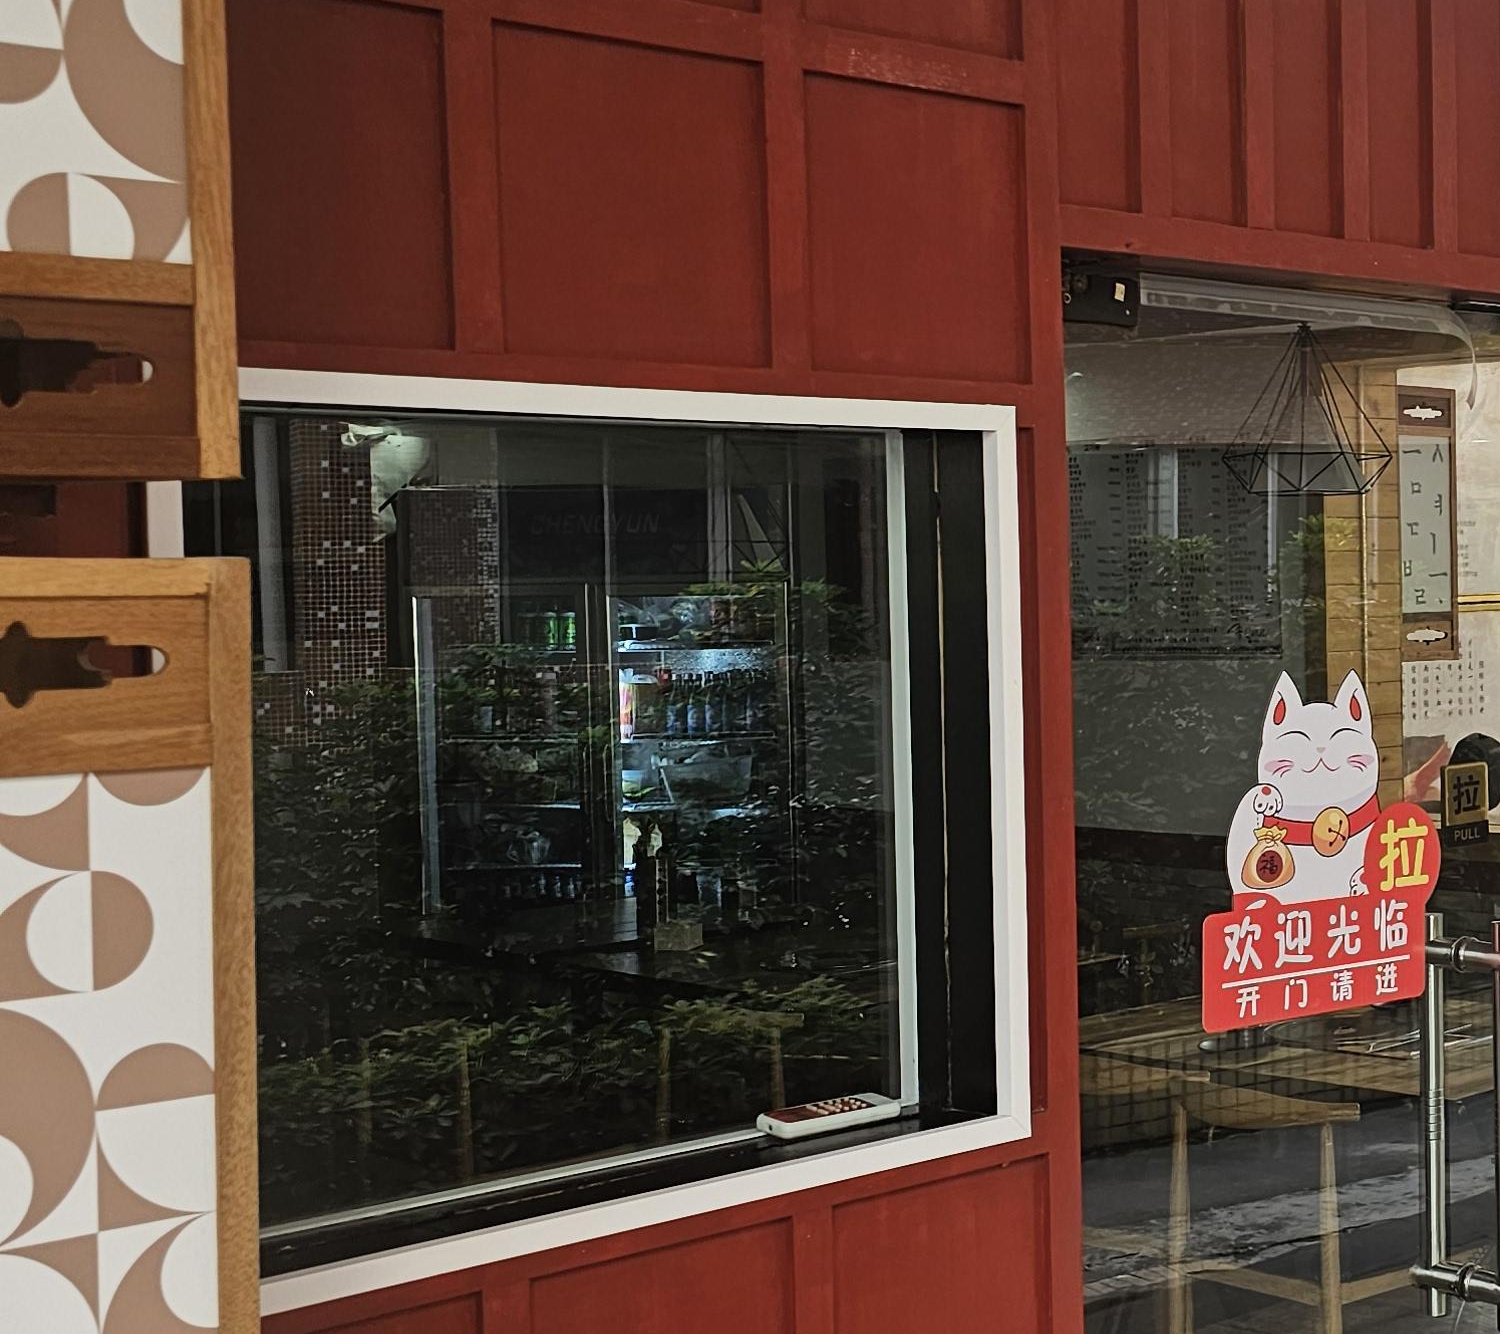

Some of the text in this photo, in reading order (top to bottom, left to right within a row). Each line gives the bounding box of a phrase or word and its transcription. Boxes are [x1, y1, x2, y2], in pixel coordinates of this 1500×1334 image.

[1453, 773, 1482, 816] 拉
[1379, 817, 1430, 892] 拉
[1454, 826, 1481, 842] PULL
[1259, 852, 1279, 877] 福
[1223, 898, 1410, 974] 欢迎光临
[1235, 964, 1400, 1019] 开门请进
